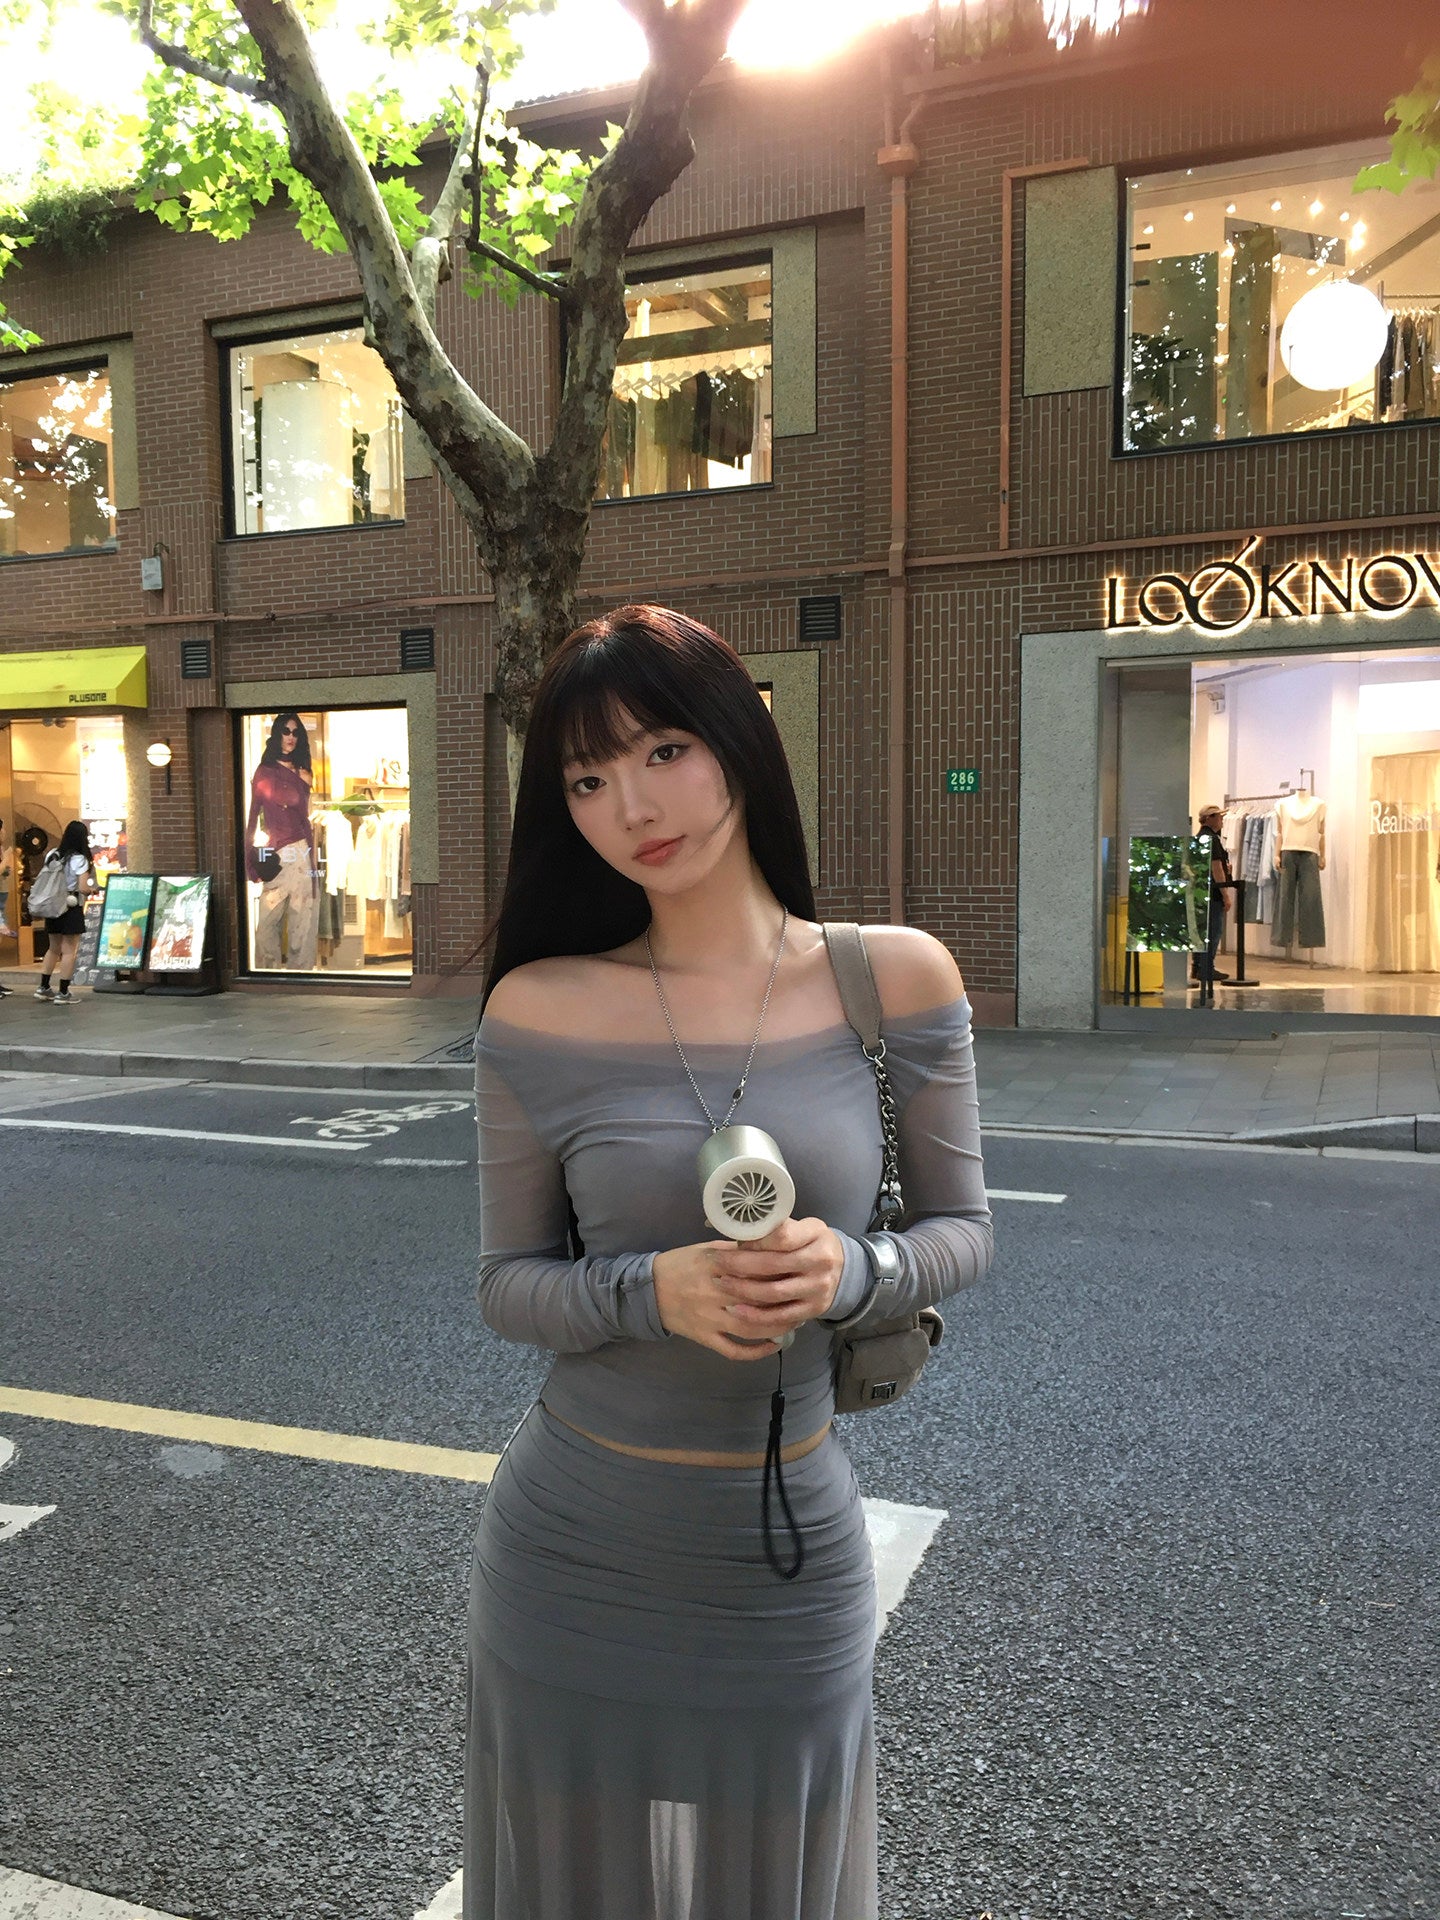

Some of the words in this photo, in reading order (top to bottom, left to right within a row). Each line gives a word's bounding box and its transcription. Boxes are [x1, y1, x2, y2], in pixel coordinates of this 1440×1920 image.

[950, 771, 975, 785] 286
[258, 847, 275, 862] IF
[282, 847, 312, 862] BY
